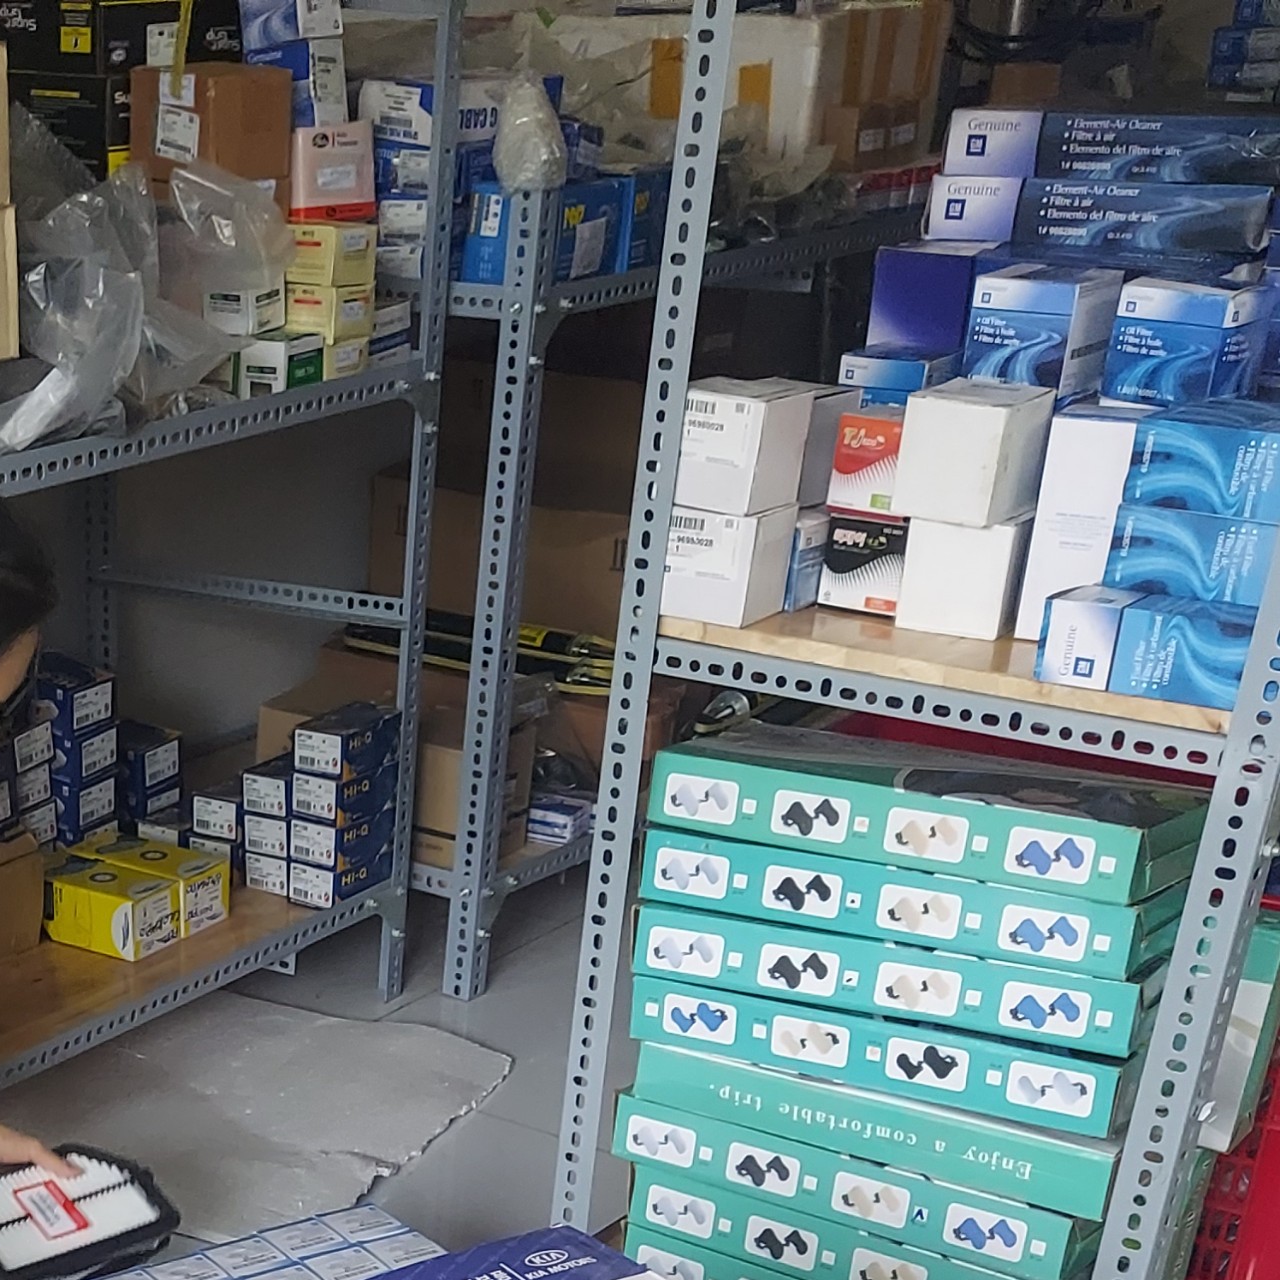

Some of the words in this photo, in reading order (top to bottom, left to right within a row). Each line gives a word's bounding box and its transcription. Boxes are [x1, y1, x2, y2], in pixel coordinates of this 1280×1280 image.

[968, 118, 1021, 132] Genuine
[947, 182, 1000, 196] Genuine
[709, 1084, 762, 1111] trip.
[778, 1101, 917, 1146] comfortable
[934, 1140, 946, 1152] a
[963, 1145, 1033, 1181] Enjoy
[549, 1256, 598, 1275] MOTORS
